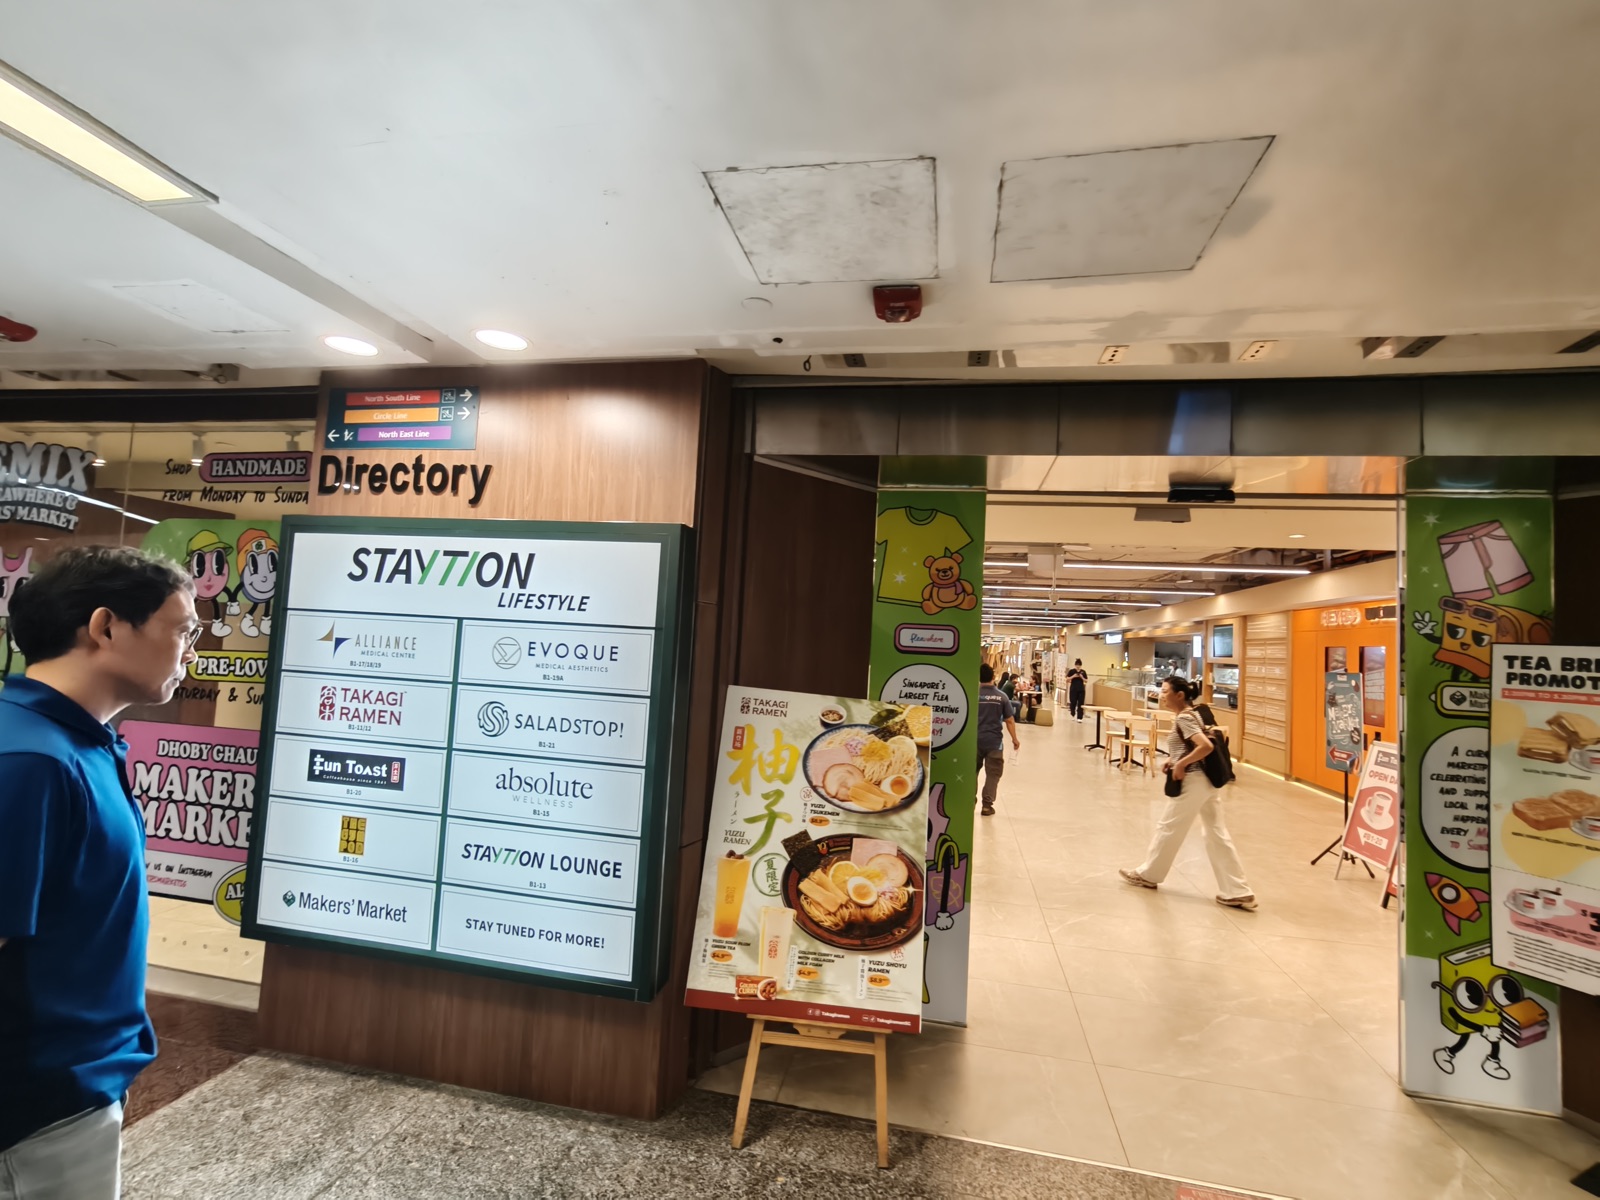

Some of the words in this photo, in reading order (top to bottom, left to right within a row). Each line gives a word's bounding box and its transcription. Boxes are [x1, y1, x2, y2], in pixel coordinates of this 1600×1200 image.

[386, 394, 405, 402] South
[373, 412, 392, 420] Circle
[393, 412, 408, 420] Line
[400, 430, 414, 438] East
[415, 430, 430, 438] Line
[211, 458, 306, 476] HANDMADE
[318, 454, 493, 508] Directory
[162, 489, 192, 502] FROM
[200, 486, 247, 504] MONDAY
[253, 490, 266, 503] TO
[16, 506, 79, 530] MARKET
[497, 592, 590, 612] LIFESTYLE
[355, 634, 417, 651] ALLIANCE
[391, 651, 415, 659] CENTRE
[528, 641, 619, 661] EVOQUE
[349, 660, 382, 668] B1-17/18/19
[568, 665, 609, 673] AESTHETICS
[1503, 655, 1552, 671] TEA
[228, 687, 239, 702] &
[340, 687, 404, 707] TAKAGI
[899, 690, 929, 701] LARGEST
[933, 692, 949, 702] FLEA
[753, 698, 789, 709] TAKAGI
[339, 706, 402, 726] RAMEN
[752, 707, 788, 718] RAMEN
[348, 723, 372, 732] B1-11/12
[514, 713, 624, 738] SALADSTOP!
[158, 740, 212, 760] DHOBY
[212, 745, 258, 764] GHAU
[1451, 746, 1459, 757] A
[1368, 770, 1389, 782] OPEN
[132, 762, 255, 808] MAKER
[495, 767, 594, 799] absolute
[346, 788, 362, 796] B1-20
[1439, 787, 1457, 795] AND
[512, 794, 574, 809] WELLNESS
[1444, 801, 1468, 810] LOCAL
[532, 809, 550, 817] B1-15
[724, 829, 745, 837] YUZU
[1440, 827, 1469, 836] EVERY
[723, 836, 751, 845] RAMEN
[342, 856, 359, 864] B1-16
[550, 854, 623, 879] LOUNGE
[529, 881, 547, 889] B1-13
[298, 891, 355, 915] Makers'
[356, 899, 408, 924] Market
[465, 917, 494, 932] STAY
[496, 922, 536, 939] TUNED
[538, 929, 563, 943] FOR
[565, 933, 605, 949] MORE!
